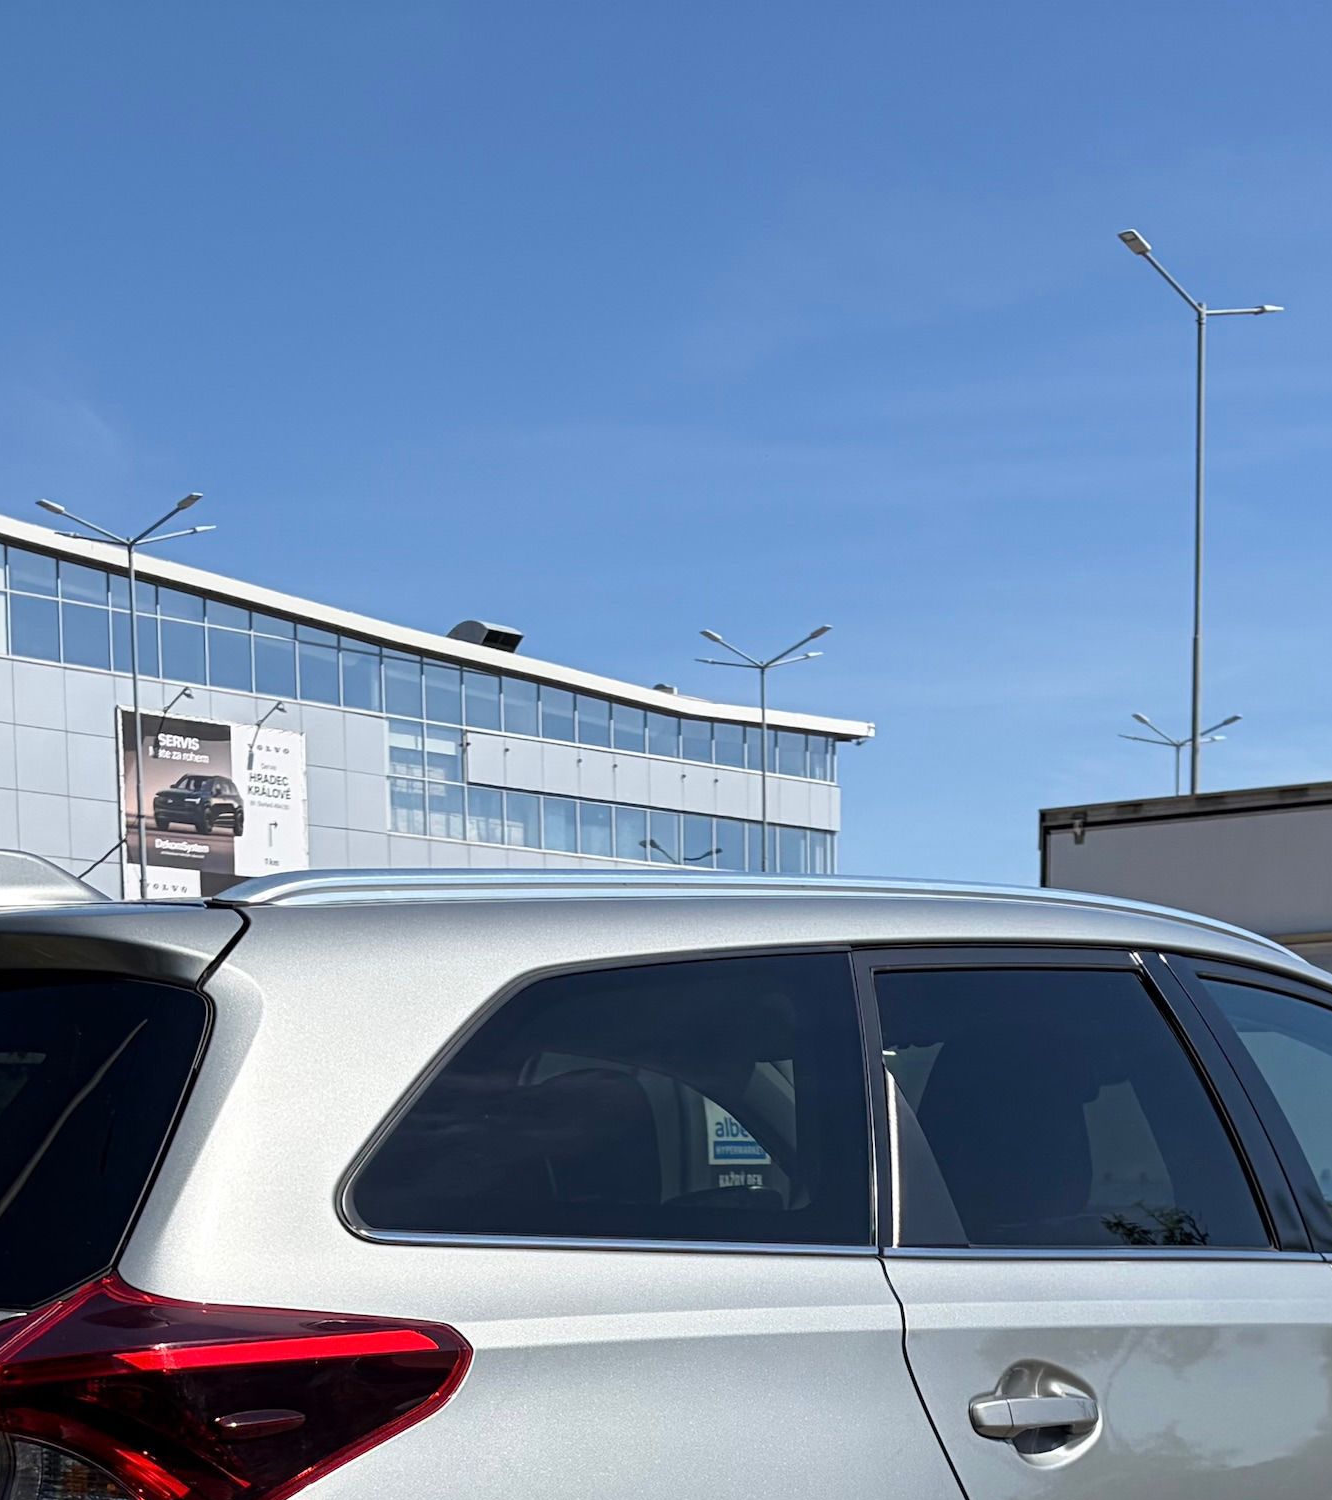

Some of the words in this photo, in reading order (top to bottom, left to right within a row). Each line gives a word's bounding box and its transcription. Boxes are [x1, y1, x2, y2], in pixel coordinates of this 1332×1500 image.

[157, 733, 200, 751] SERVIS
[249, 773, 289, 786] HRADEC
[247, 783, 292, 801] KRÁLOVÉ
